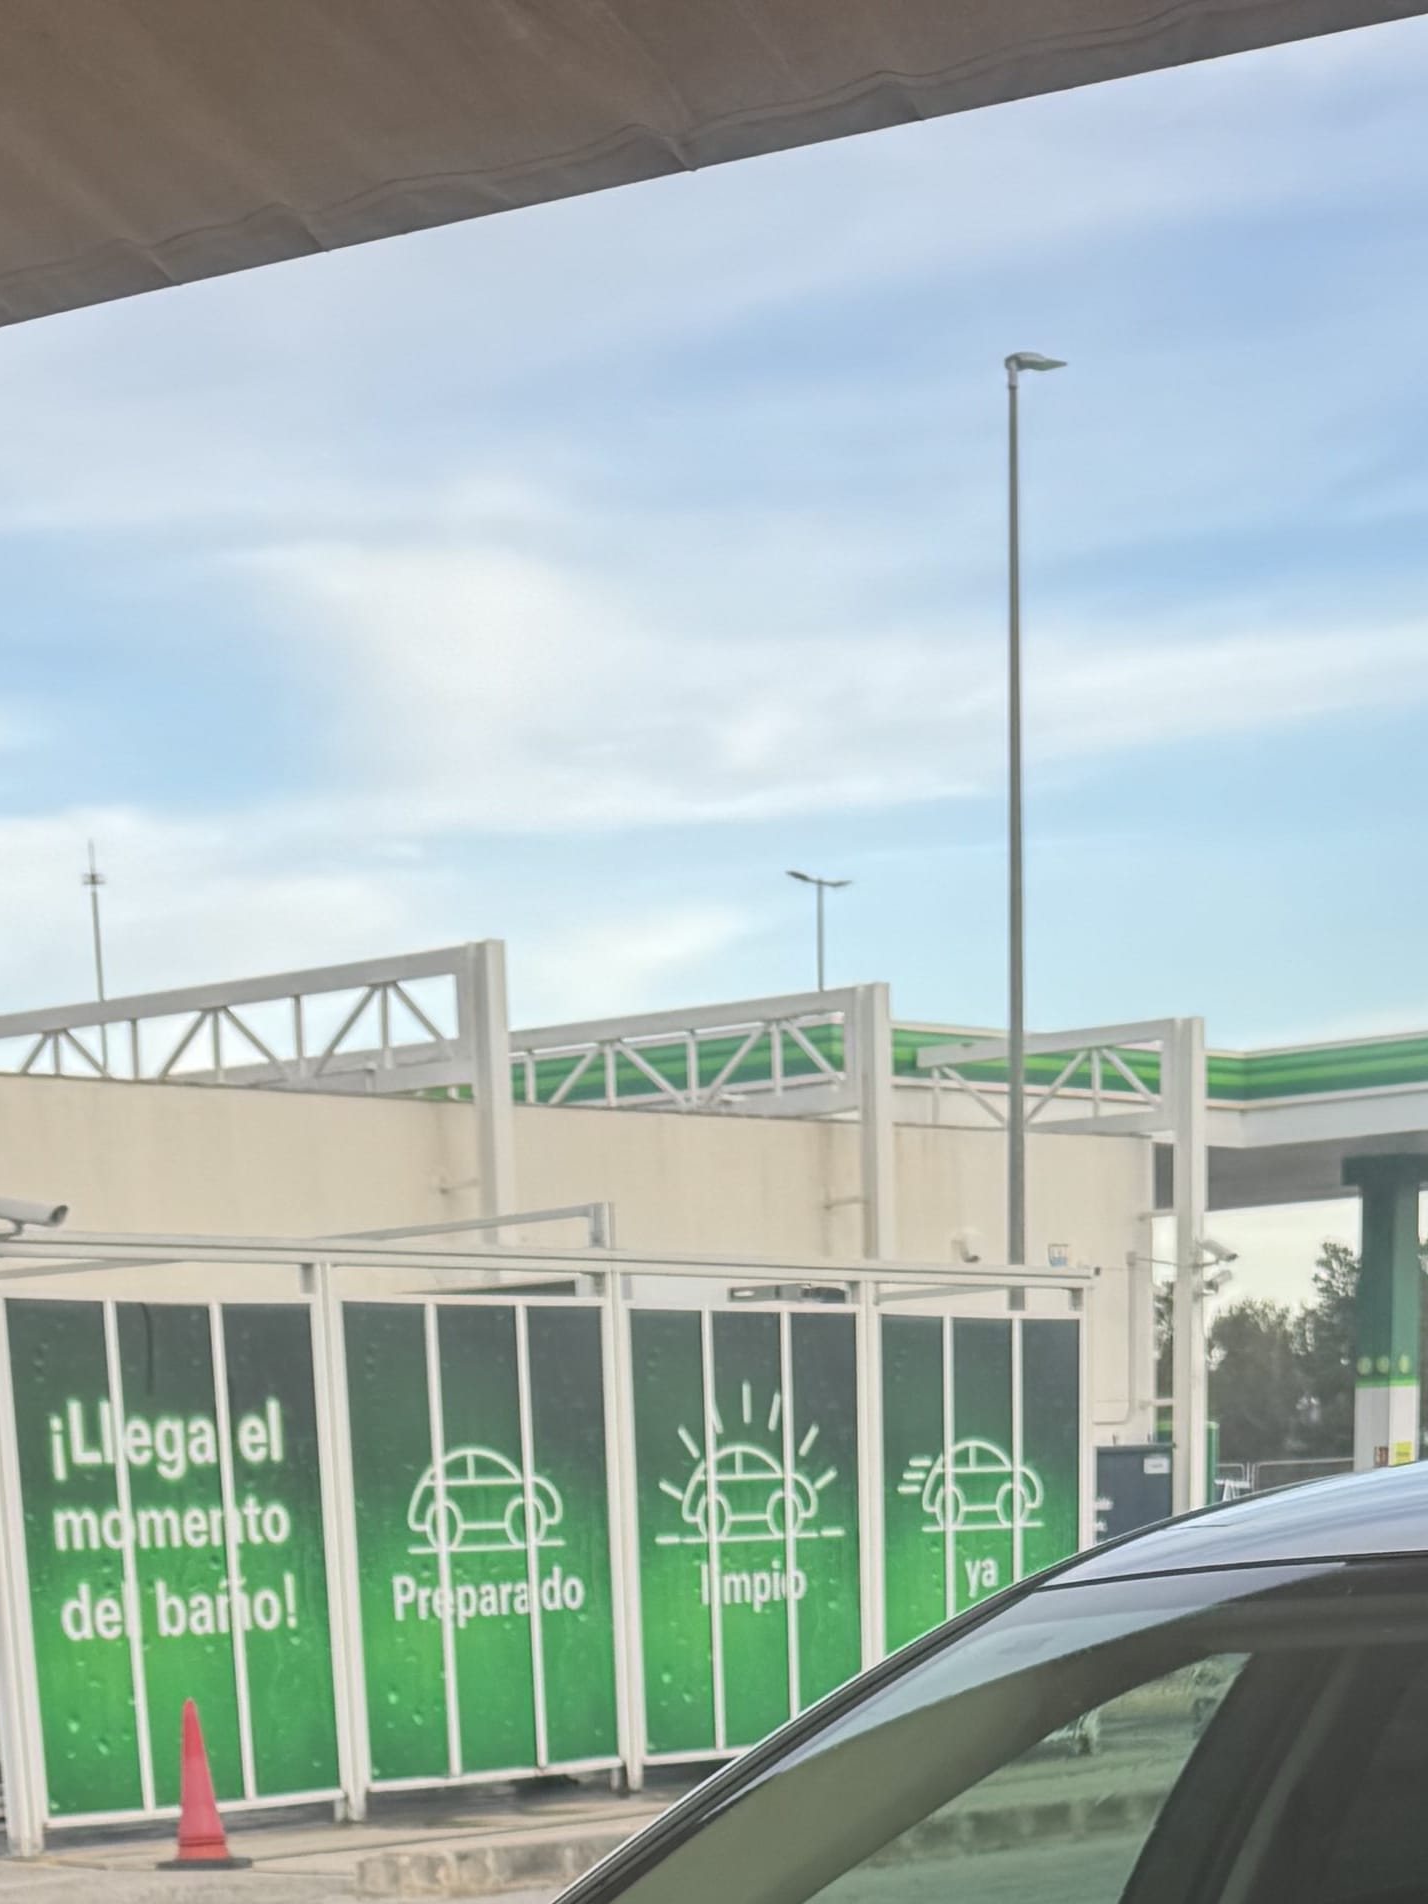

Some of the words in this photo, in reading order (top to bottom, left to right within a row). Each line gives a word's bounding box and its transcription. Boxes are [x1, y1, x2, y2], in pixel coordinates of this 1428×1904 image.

[48, 1397, 218, 1482] ¡Llega
[237, 1396, 284, 1463] el
[53, 1495, 291, 1551] momento
[154, 1569, 299, 1638] baño!
[391, 1565, 586, 1629] Preparado
[700, 1558, 807, 1614] lmpio
[964, 1557, 1000, 1599] ya
